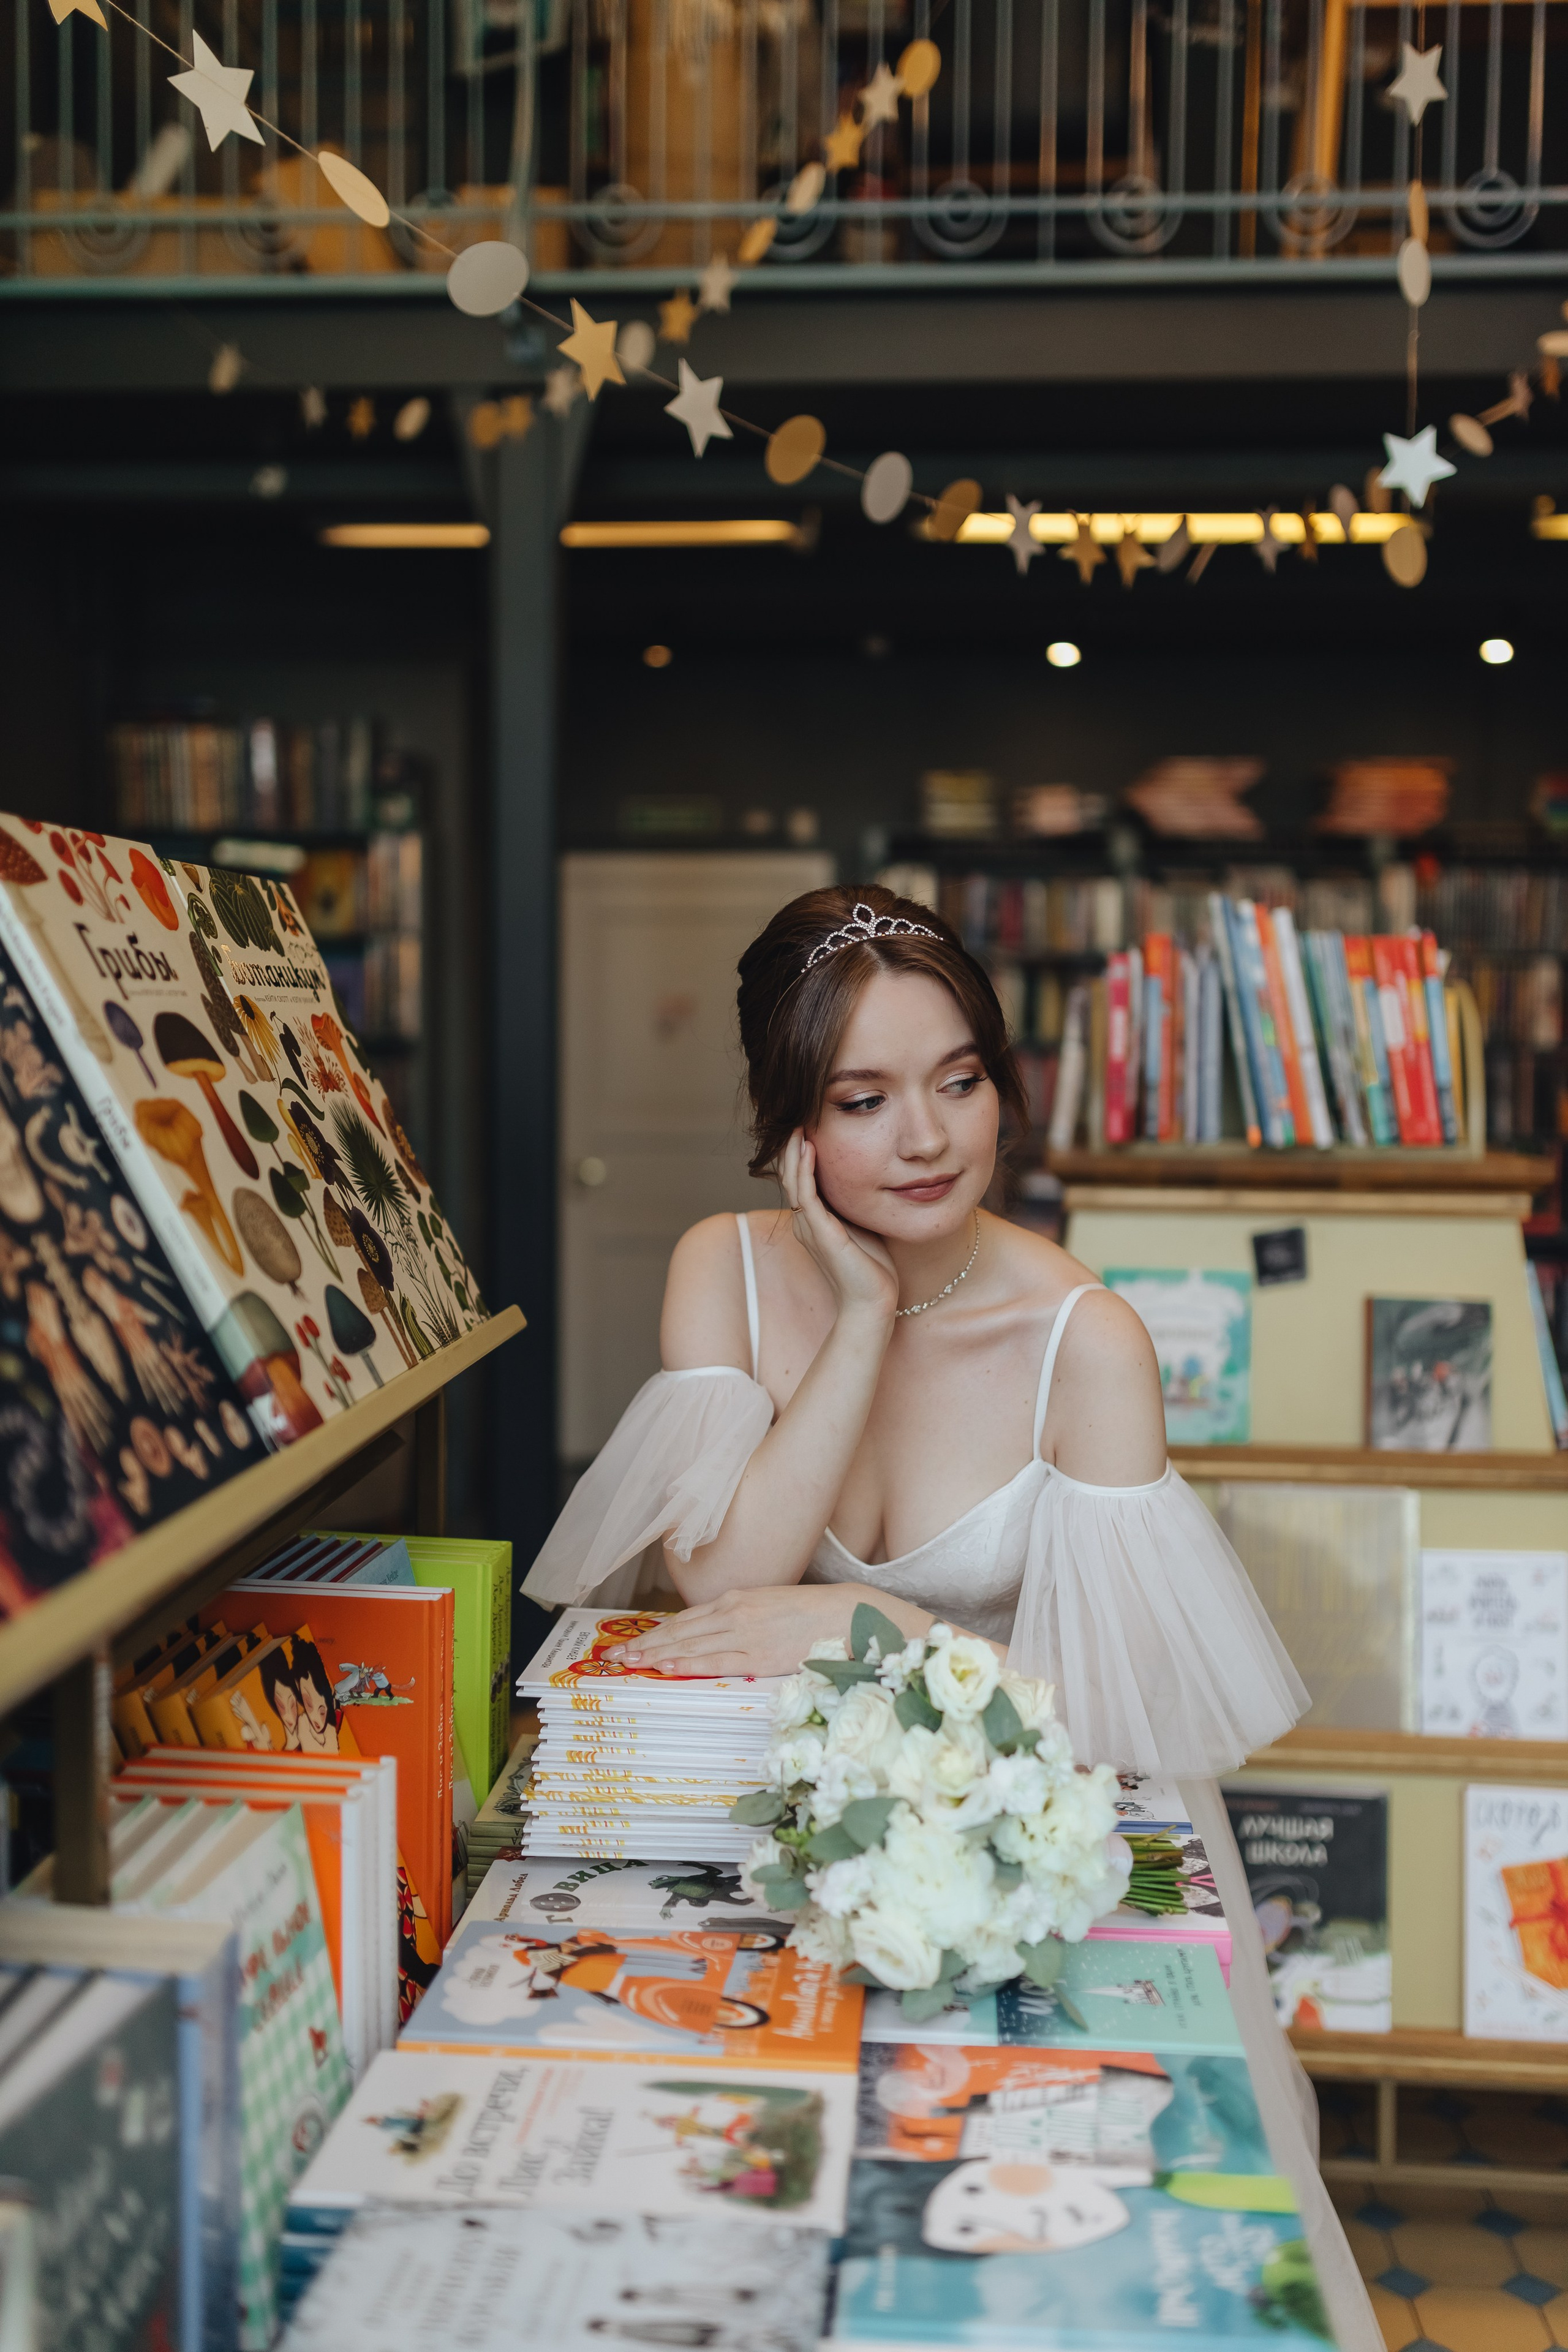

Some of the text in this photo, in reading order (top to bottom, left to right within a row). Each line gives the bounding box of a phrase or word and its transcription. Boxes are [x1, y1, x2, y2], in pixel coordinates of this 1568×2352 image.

[73, 921, 179, 1001] Грибы
[221, 944, 326, 1003] Ботаникум
[1237, 1815, 1335, 1842] ЛУЧШАЯ
[1245, 1841, 1329, 1868] ШКОЛА
[494, 1891, 519, 1923] Арнольд
[509, 1873, 529, 1893] Лобел
[497, 2151, 549, 2197] Лис
